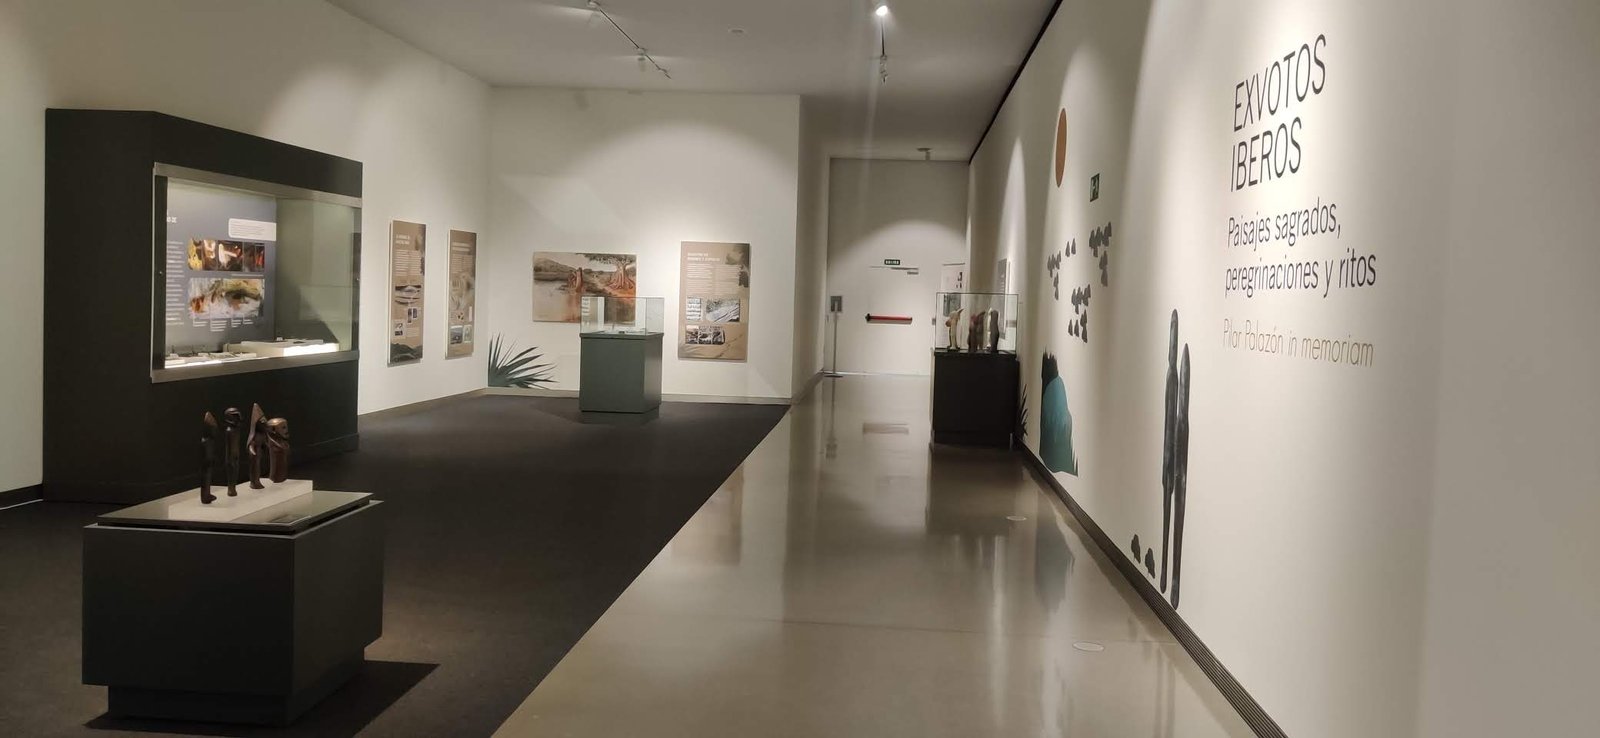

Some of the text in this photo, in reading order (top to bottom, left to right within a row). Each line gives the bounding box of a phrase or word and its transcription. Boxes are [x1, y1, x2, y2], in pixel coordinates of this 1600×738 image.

[1234, 34, 1326, 132] EXVOTOS
[1231, 117, 1302, 192] IBEROS
[1228, 197, 1341, 251] Paisajes sagrados,
[1225, 247, 1376, 298] peregrinaciones y ritos
[1223, 318, 1374, 367] Pilar Palazón in memoriam
